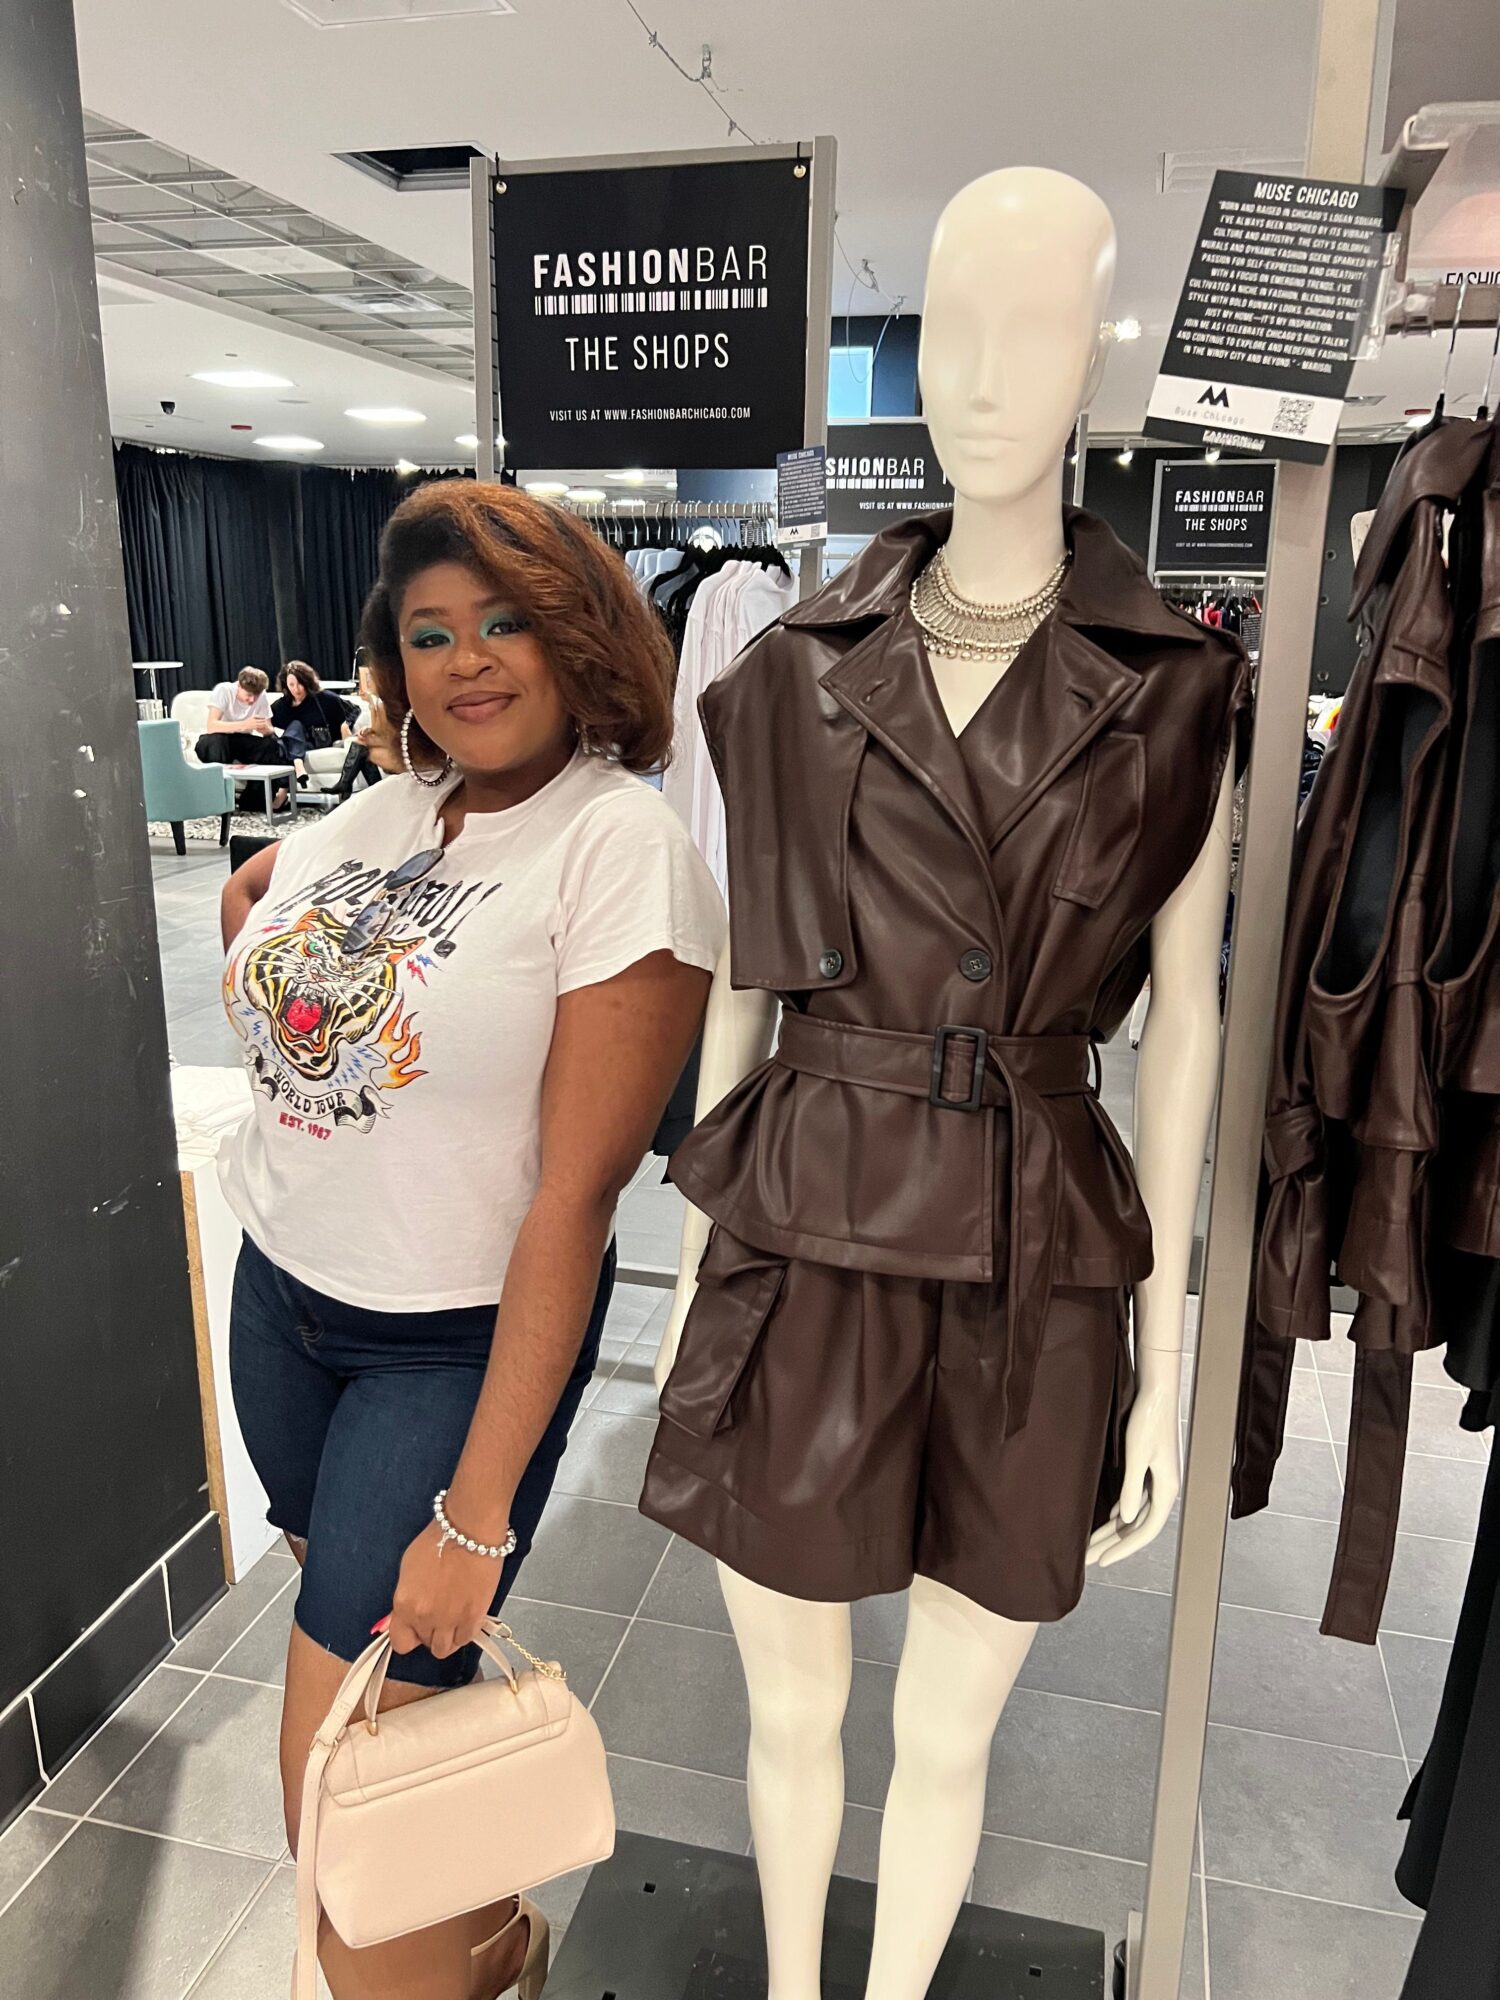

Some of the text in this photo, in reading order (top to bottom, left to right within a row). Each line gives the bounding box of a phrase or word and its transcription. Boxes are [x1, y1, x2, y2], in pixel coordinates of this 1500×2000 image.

[1254, 182, 1359, 208] MUSE CHICAGO
[1241, 204, 1256, 212] AND
[1282, 208, 1290, 216] IN
[1329, 214, 1353, 224] LOGAN
[1236, 217, 1265, 227] ALWAYS
[1265, 220, 1284, 229] BEEN
[1285, 223, 1317, 233] INSPIRED
[1318, 226, 1328, 235] BY
[1329, 227, 1342, 236] ITS
[1213, 228, 1243, 238] CULTURE
[1245, 232, 1260, 240] AND
[1298, 238, 1311, 247] THE
[1201, 240, 1229, 250] MURALS
[1230, 244, 1245, 252] AND
[1245, 246, 1277, 256] DYNAMIC
[1277, 249, 1308, 260] FASHION
[1308, 253, 1331, 263] SCENE
[1332, 256, 1366, 267] SPARKED
[533, 244, 768, 289] FASHIONBAR
[1201, 254, 1231, 265] PASSION
[1232, 257, 1245, 266] FOR
[1309, 267, 1325, 275] AND
[1210, 268, 1229, 277] WITH
[1259, 274, 1269, 282] ON
[1189, 279, 1231, 291] CULTIVATED
[1259, 287, 1267, 296] IN
[1301, 293, 1336, 304] BLENDING
[1188, 293, 1210, 302] STYLE
[1210, 295, 1229, 304] WITH
[1229, 298, 1248, 307] BOLD
[1248, 300, 1278, 310] RUNWAY
[1304, 307, 1336, 318] CHICAGO
[1336, 311, 1345, 320] IS
[1205, 308, 1221, 317] JUST
[1222, 310, 1233, 318] MY
[1276, 317, 1287, 325] MY
[1184, 319, 1199, 328] JOIN
[1199, 320, 1210, 329] ME
[1211, 322, 1221, 331] AS
[1226, 324, 1265, 337] CELEBRATE
[1303, 334, 1321, 343] RICH
[1321, 336, 1349, 347] TALENT
[565, 333, 729, 371] THE SHOPS
[1177, 331, 1349, 361] AND CONTINUE TO EXPLORE AND REDEFINE FASHION
[1183, 345, 1191, 353] IN
[1192, 346, 1205, 355] THE
[1206, 349, 1229, 359] WINDY
[1230, 352, 1246, 361] CITY
[1246, 354, 1262, 363] AND
[550, 407, 751, 422] VISIT US AT WWW.FASHIONBARCHICAGO.COM
[860, 502, 875, 510] VISIT
[877, 502, 885, 510] US
[887, 502, 895, 510] AT
[1175, 490, 1264, 503] FASHIONBAR
[1185, 518, 1247, 531] THE SHOPS
[273, 1066, 346, 1114] WORLD TOUR
[279, 1112, 305, 1132] EST.
